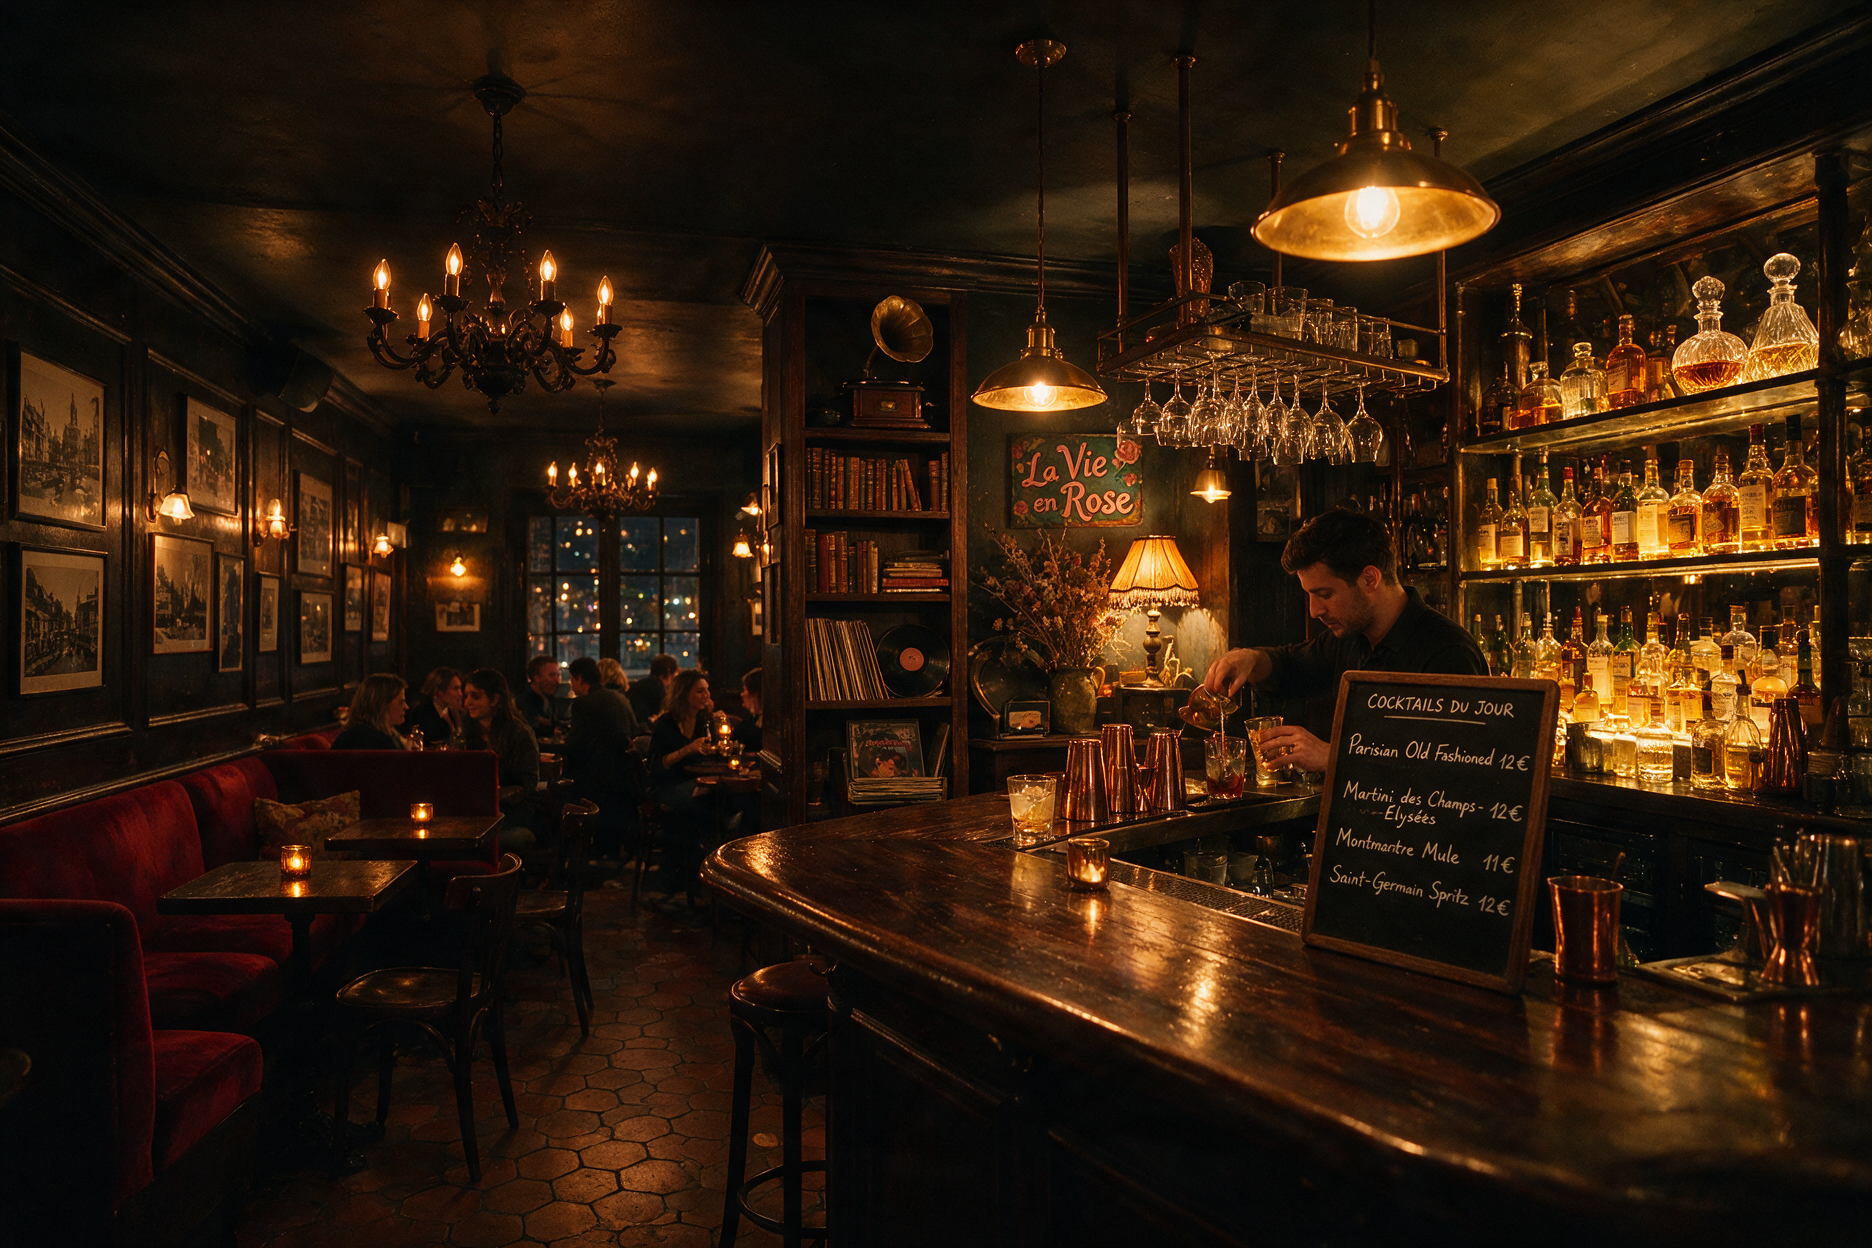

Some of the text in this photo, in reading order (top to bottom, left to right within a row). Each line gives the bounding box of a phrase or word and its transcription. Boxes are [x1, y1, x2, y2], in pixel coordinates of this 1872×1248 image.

[1021, 442, 1108, 488] La Vie
[1033, 481, 1134, 522] en Rose
[1367, 693, 1515, 718] COCKTAILS DU JOUR
[1348, 732, 1531, 772] Parisian Old Fashioned 12€
[1342, 779, 1523, 822] Martini des Champs- 12€
[1421, 841, 1460, 865] Mule
[1482, 853, 1516, 874] 11€
[1329, 864, 1511, 916] Saint-Germain Spritz 12€
